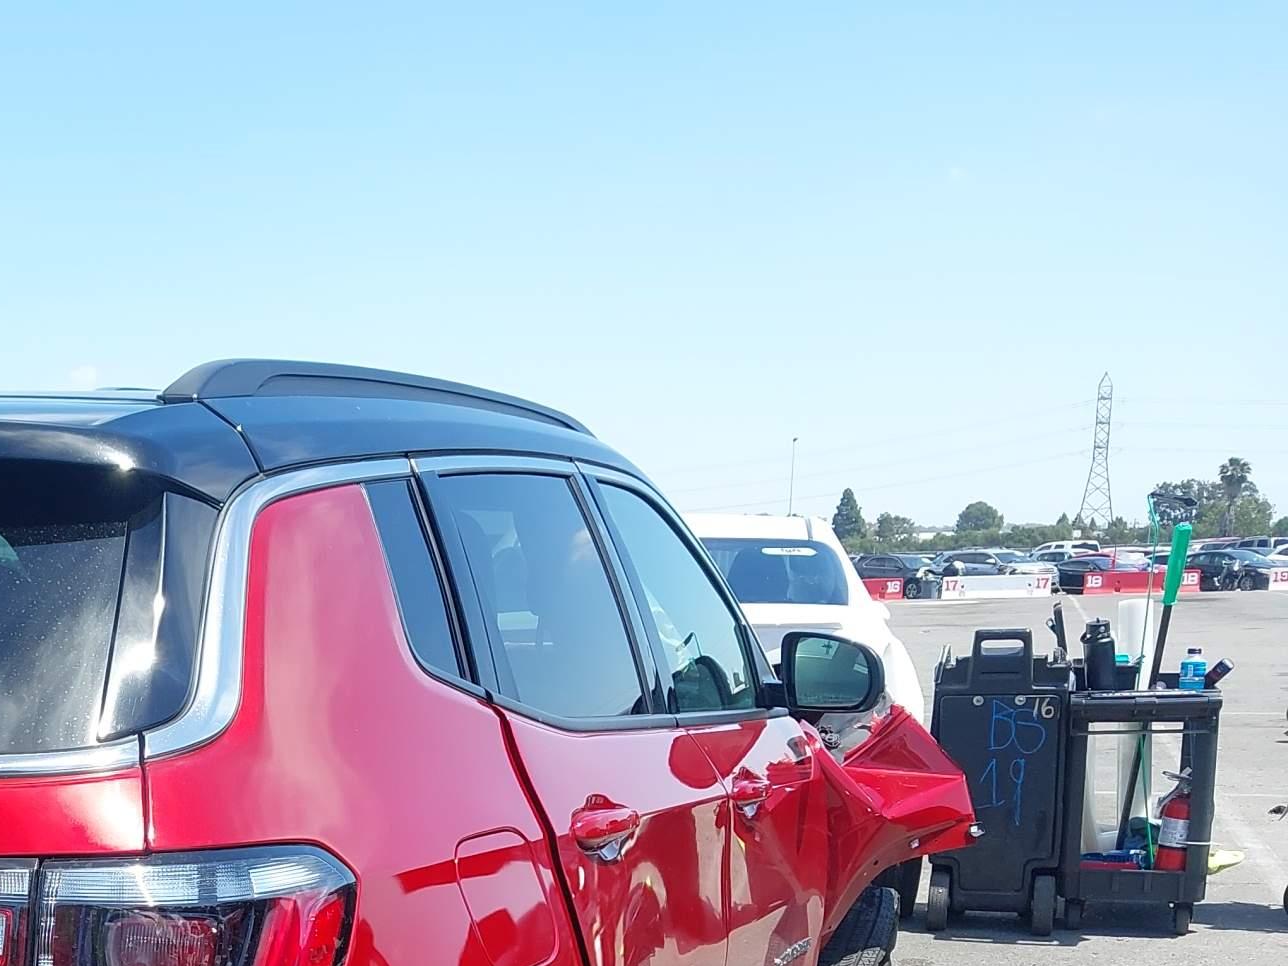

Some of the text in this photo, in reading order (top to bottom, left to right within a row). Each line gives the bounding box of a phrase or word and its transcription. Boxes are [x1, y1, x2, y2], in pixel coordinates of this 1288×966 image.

[1035, 578, 1049, 589] 17
[1086, 575, 1103, 588] 18
[1181, 572, 1198, 585] 18
[944, 580, 958, 591] 17
[1033, 697, 1055, 718] 16
